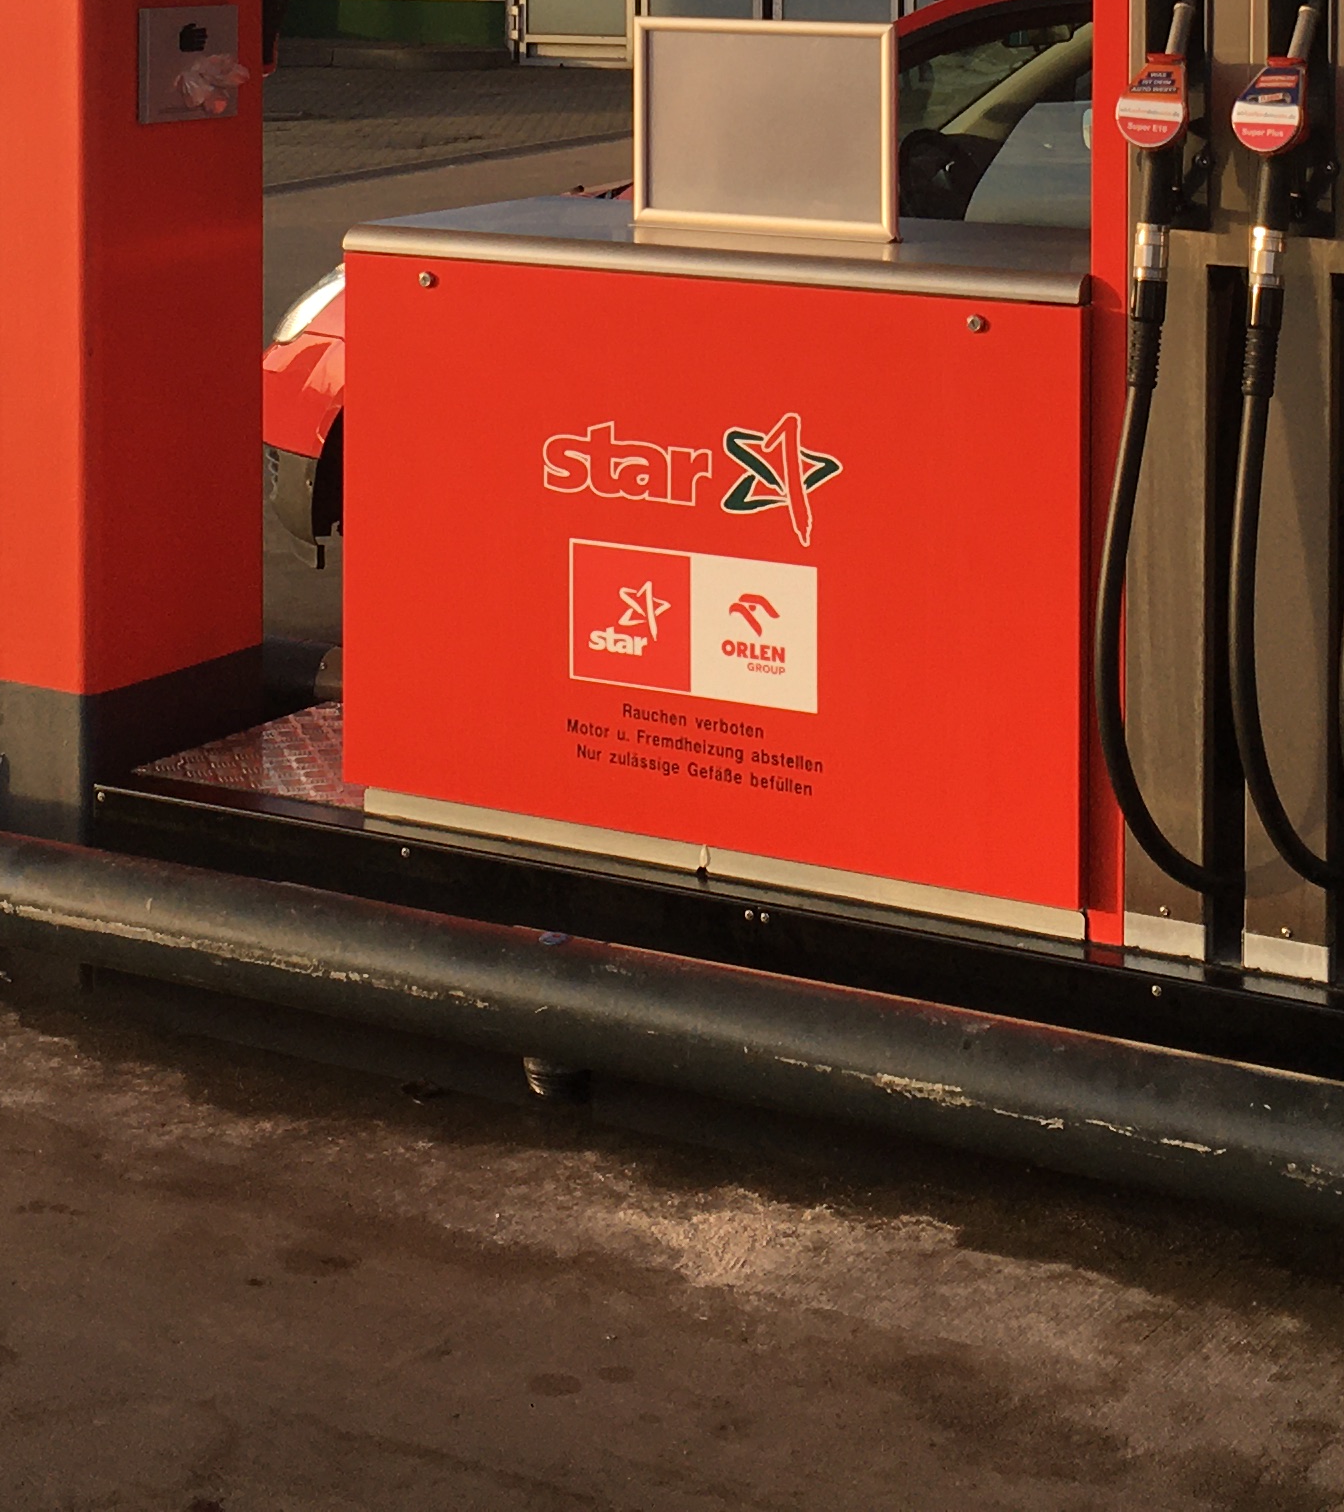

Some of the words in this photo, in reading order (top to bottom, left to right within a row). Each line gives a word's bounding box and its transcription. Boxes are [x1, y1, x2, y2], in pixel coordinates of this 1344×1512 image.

[1127, 121, 1151, 132] Super
[1241, 127, 1265, 137] Super
[1266, 128, 1284, 137] Plus
[542, 421, 712, 506] star
[588, 626, 648, 656] star
[721, 639, 786, 664] ORLEN
[746, 662, 786, 676] GROUP
[622, 703, 687, 727] Rauchen
[695, 716, 764, 739] verboten
[566, 718, 609, 739] Motor
[617, 729, 630, 742] u.
[637, 729, 744, 764] Fremdheizung
[751, 749, 823, 774] abstellen
[576, 743, 602, 762] Nur
[609, 751, 680, 776] zulässige
[687, 761, 742, 785] Gefäße
[750, 772, 813, 797] befüllen
